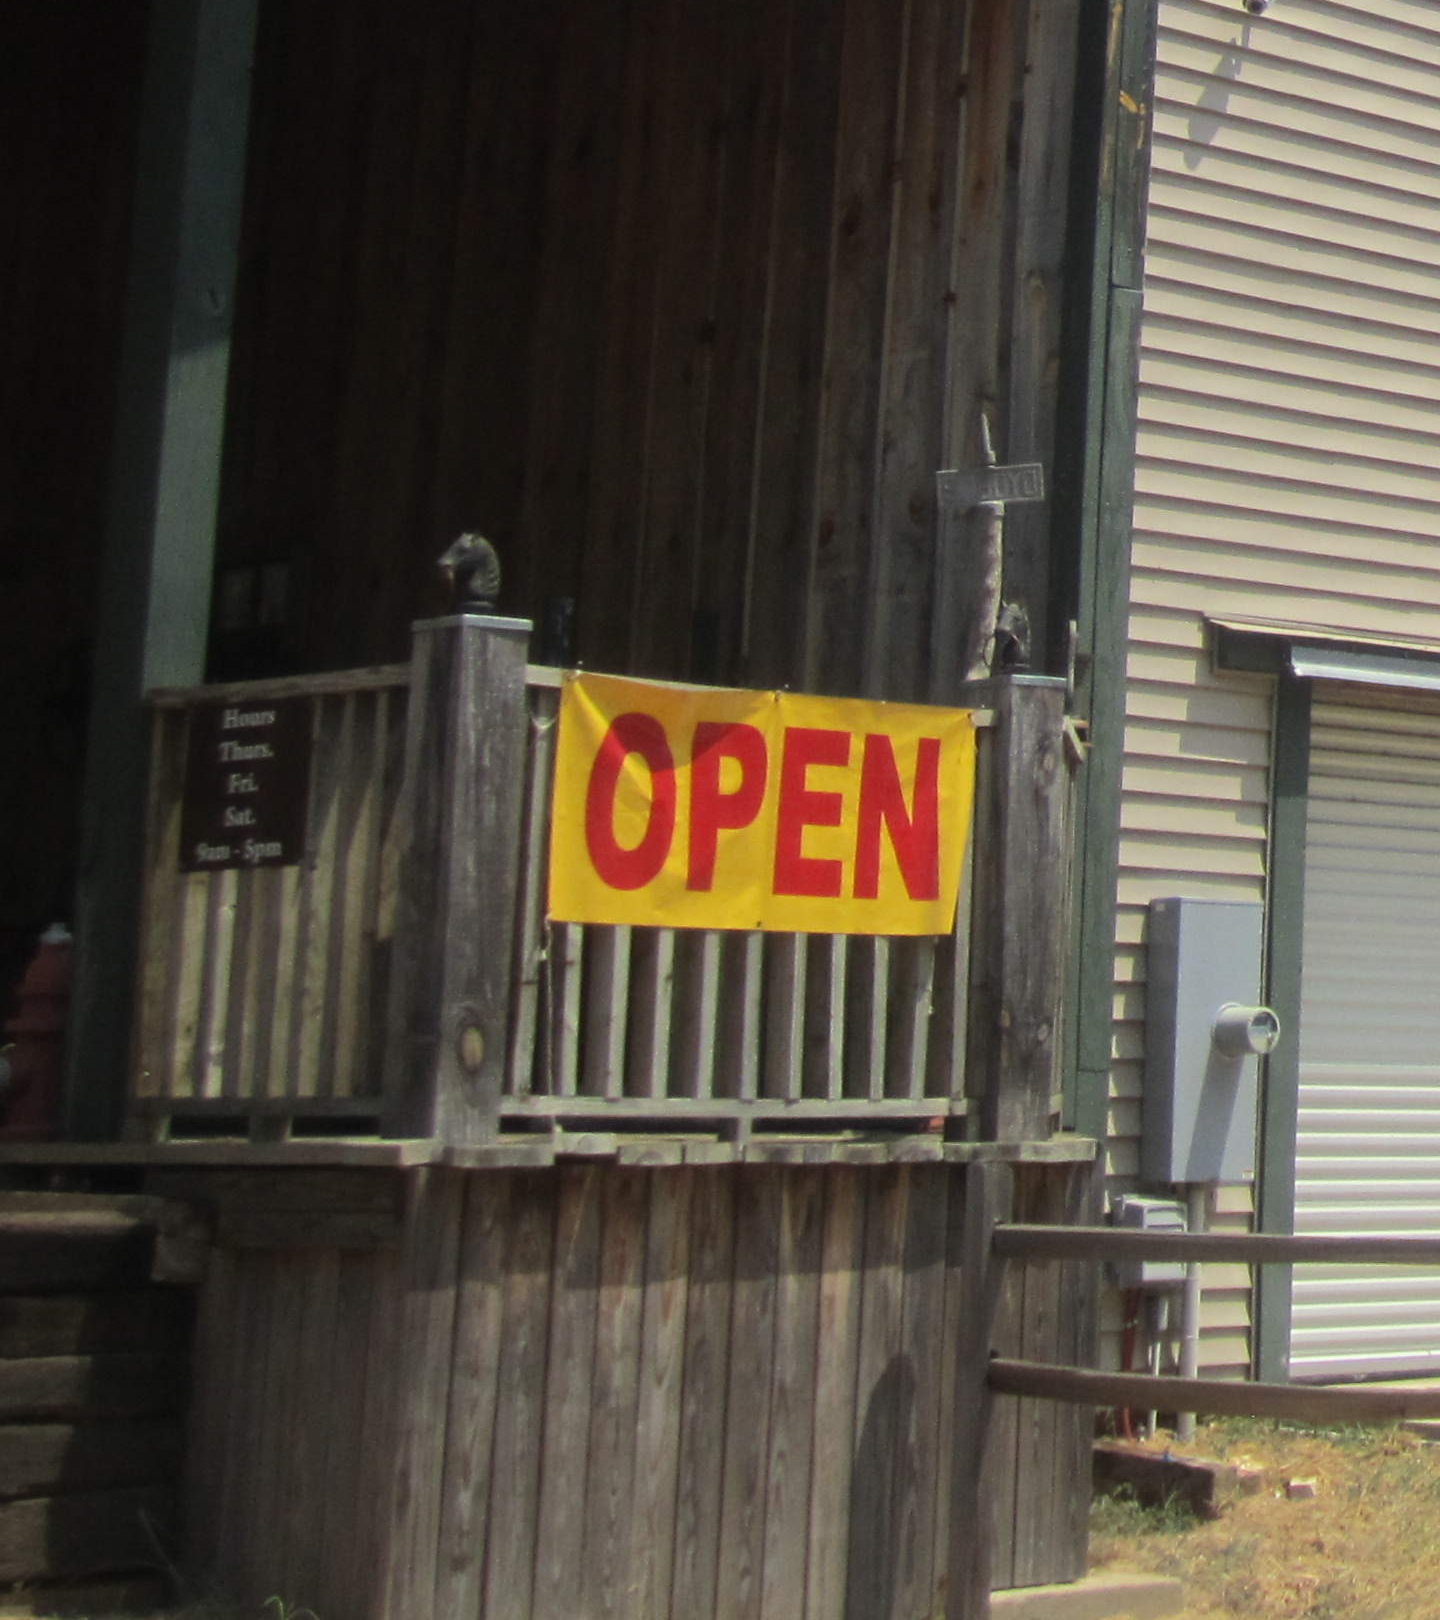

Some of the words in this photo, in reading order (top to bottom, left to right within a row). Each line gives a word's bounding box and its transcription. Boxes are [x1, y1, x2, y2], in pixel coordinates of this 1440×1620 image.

[222, 709, 275, 729] Hours
[220, 741, 273, 762] Thurs.
[229, 773, 258, 793] Fri.
[225, 806, 255, 826] Sat.
[584, 711, 942, 902] OPEN
[243, 839, 281, 863] 5pm
